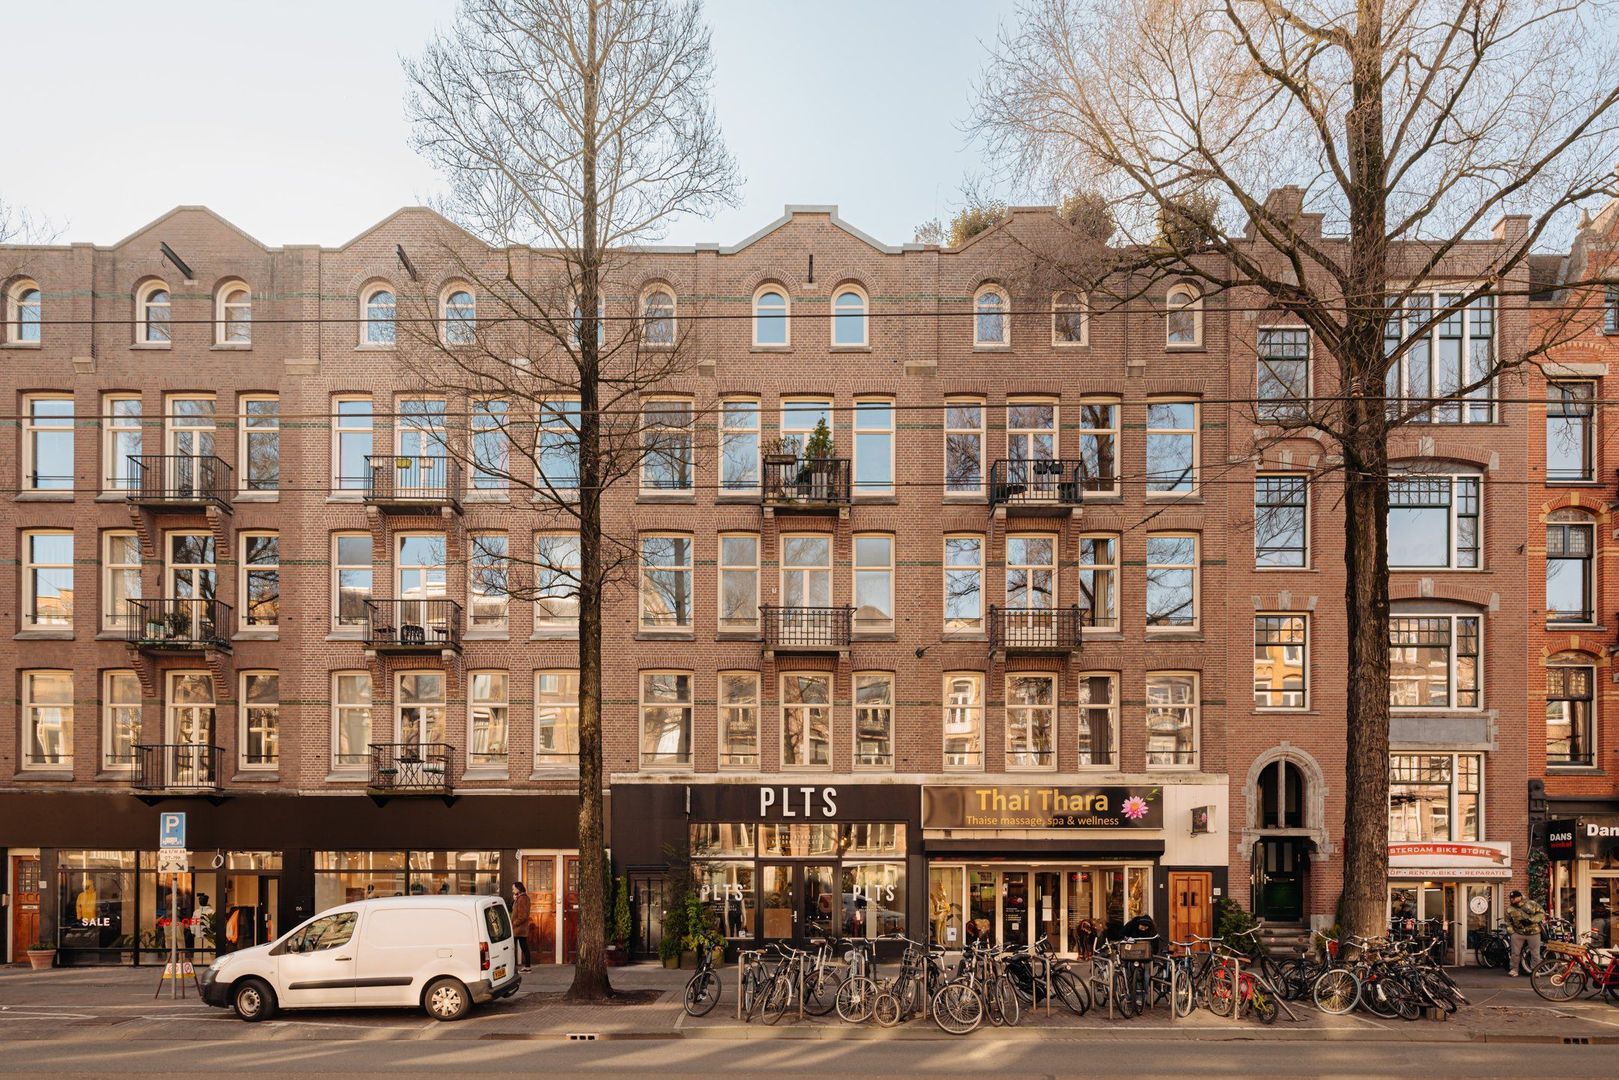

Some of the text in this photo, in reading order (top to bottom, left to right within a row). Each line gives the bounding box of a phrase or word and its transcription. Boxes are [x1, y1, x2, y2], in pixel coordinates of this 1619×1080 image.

[760, 787, 837, 817] PLTS
[976, 788, 1109, 811] Thai Thara
[166, 815, 179, 833] P
[966, 815, 1119, 827] Thaise massage, spa & wellness
[1550, 832, 1572, 841] DANS
[1389, 846, 1492, 856] STERDAM BIKE STORE
[701, 884, 744, 901] PLTS
[852, 884, 895, 902] PLTS
[81, 917, 110, 927] SALE
